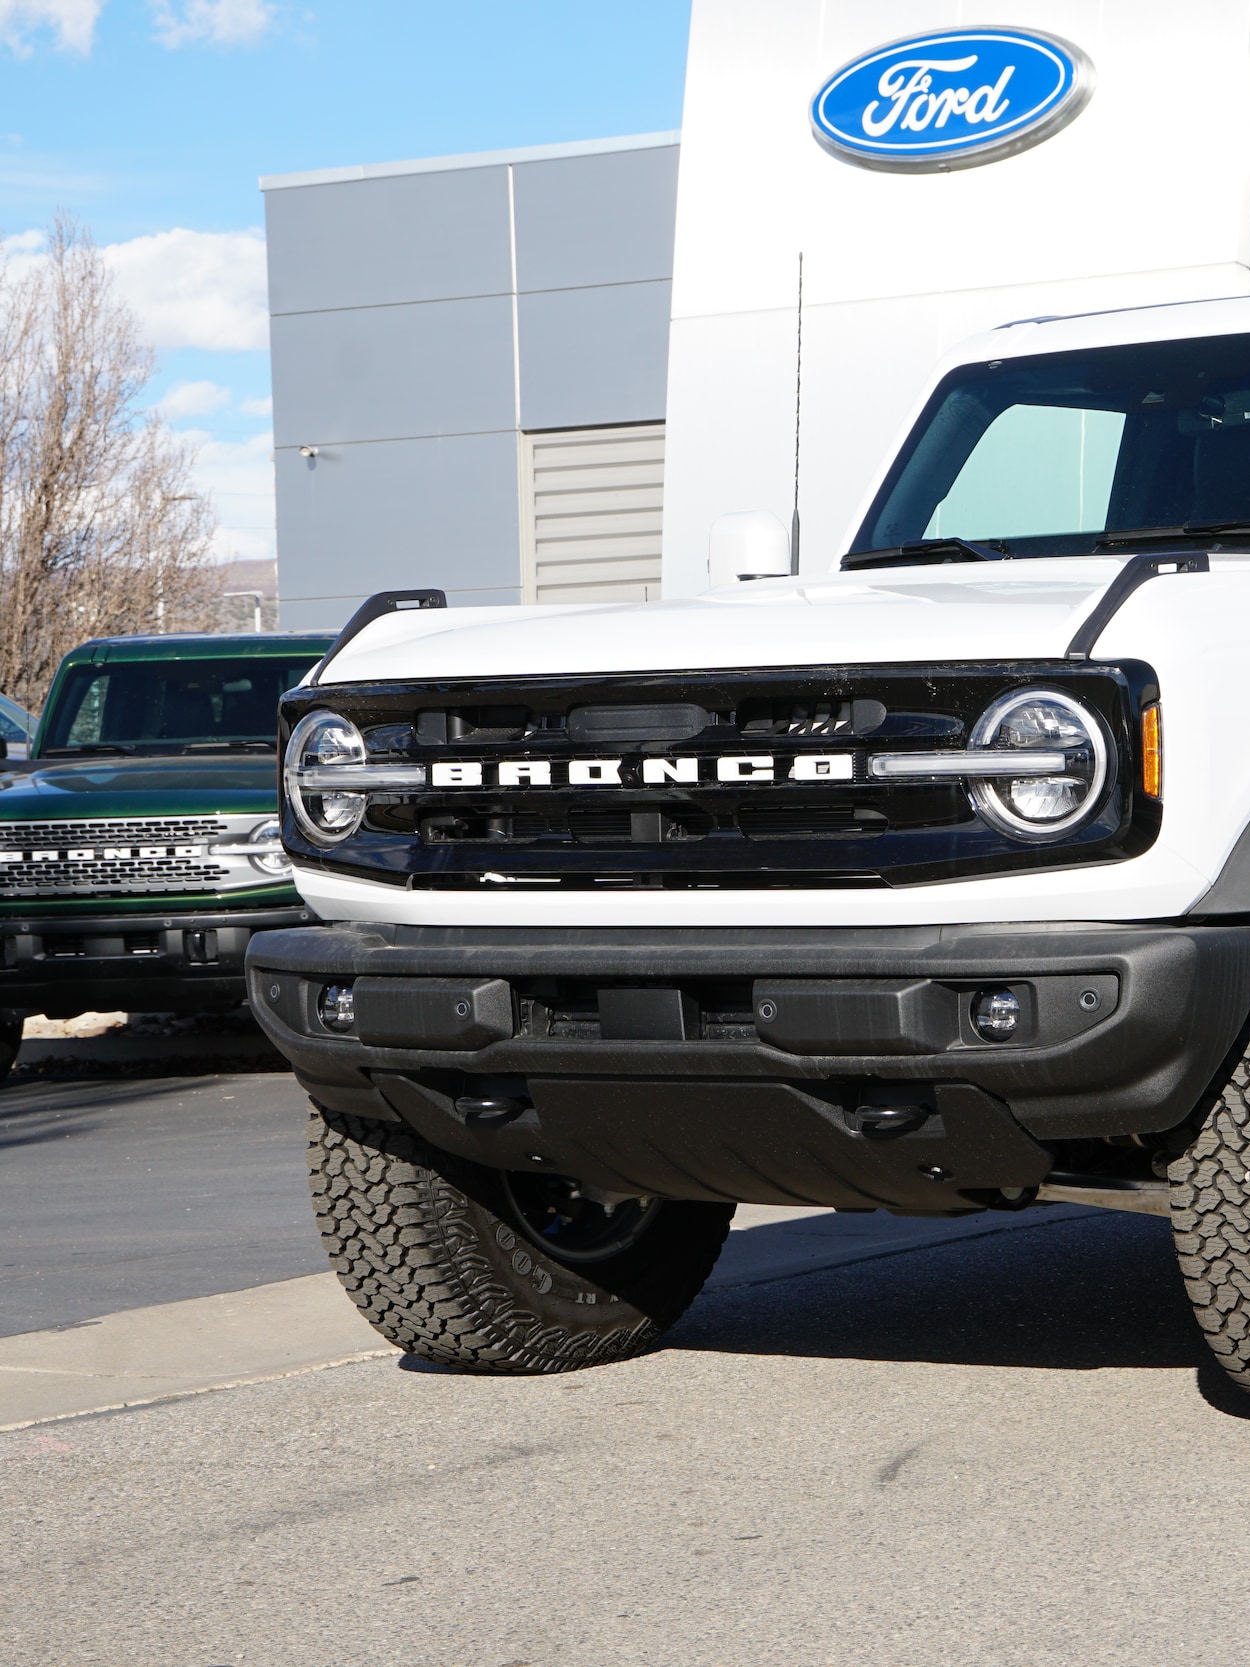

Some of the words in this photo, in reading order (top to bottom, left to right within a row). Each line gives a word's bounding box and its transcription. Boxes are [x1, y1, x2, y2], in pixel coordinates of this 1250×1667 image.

[861, 54, 1017, 138] Ford
[431, 752, 854, 788] BRONCO
[0, 845, 202, 863] BRONCO
